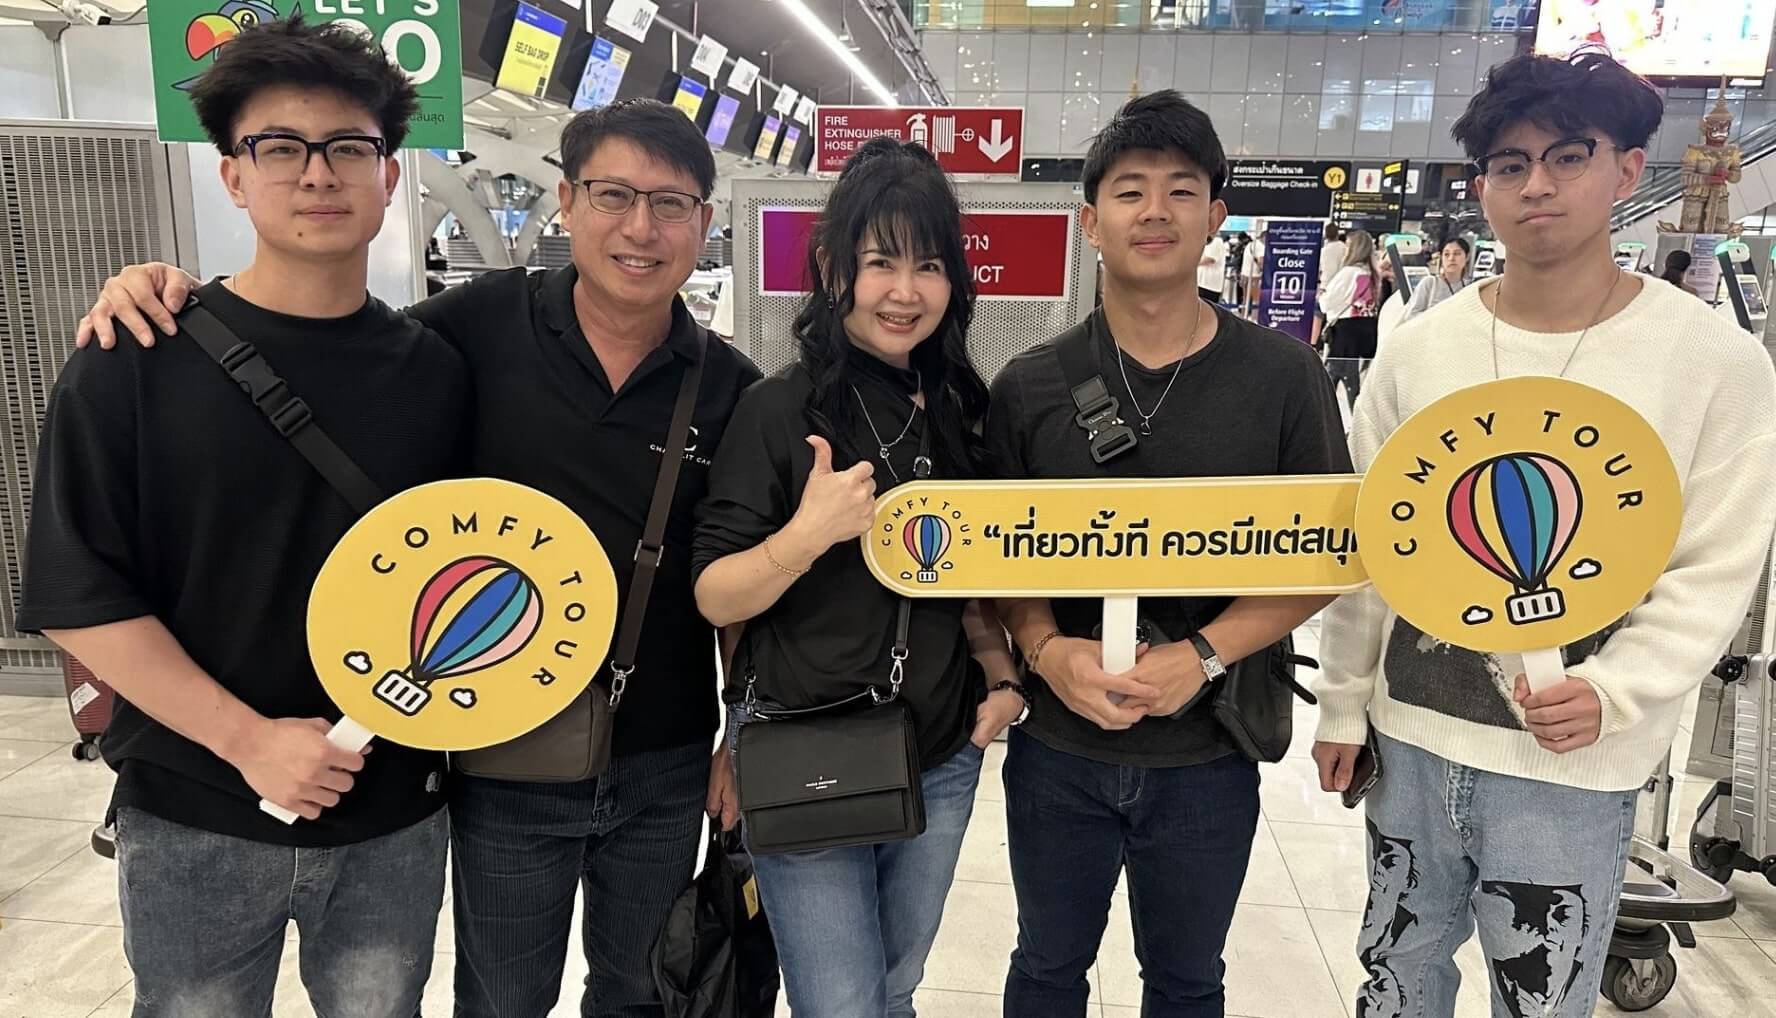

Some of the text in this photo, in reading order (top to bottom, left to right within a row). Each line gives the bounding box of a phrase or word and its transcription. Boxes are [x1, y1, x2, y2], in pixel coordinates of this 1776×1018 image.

[824, 116, 848, 126] FIRE
[824, 128, 902, 139] EXTINGUISHER
[824, 141, 854, 150] HOSE
[1328, 173, 1342, 184] Y1
[1231, 180, 1319, 190] Oversize Baggage Check-in
[1272, 248, 1299, 256] Boarding
[1278, 257, 1305, 268] Close
[1277, 276, 1301, 295] 10
[1391, 410, 1643, 556] COMFY TOUR
[882, 497, 972, 546] COMFY TOUR
[984, 506, 1149, 558] “เที่ยวทั้งที
[371, 512, 587, 687] COMFY TOUR
